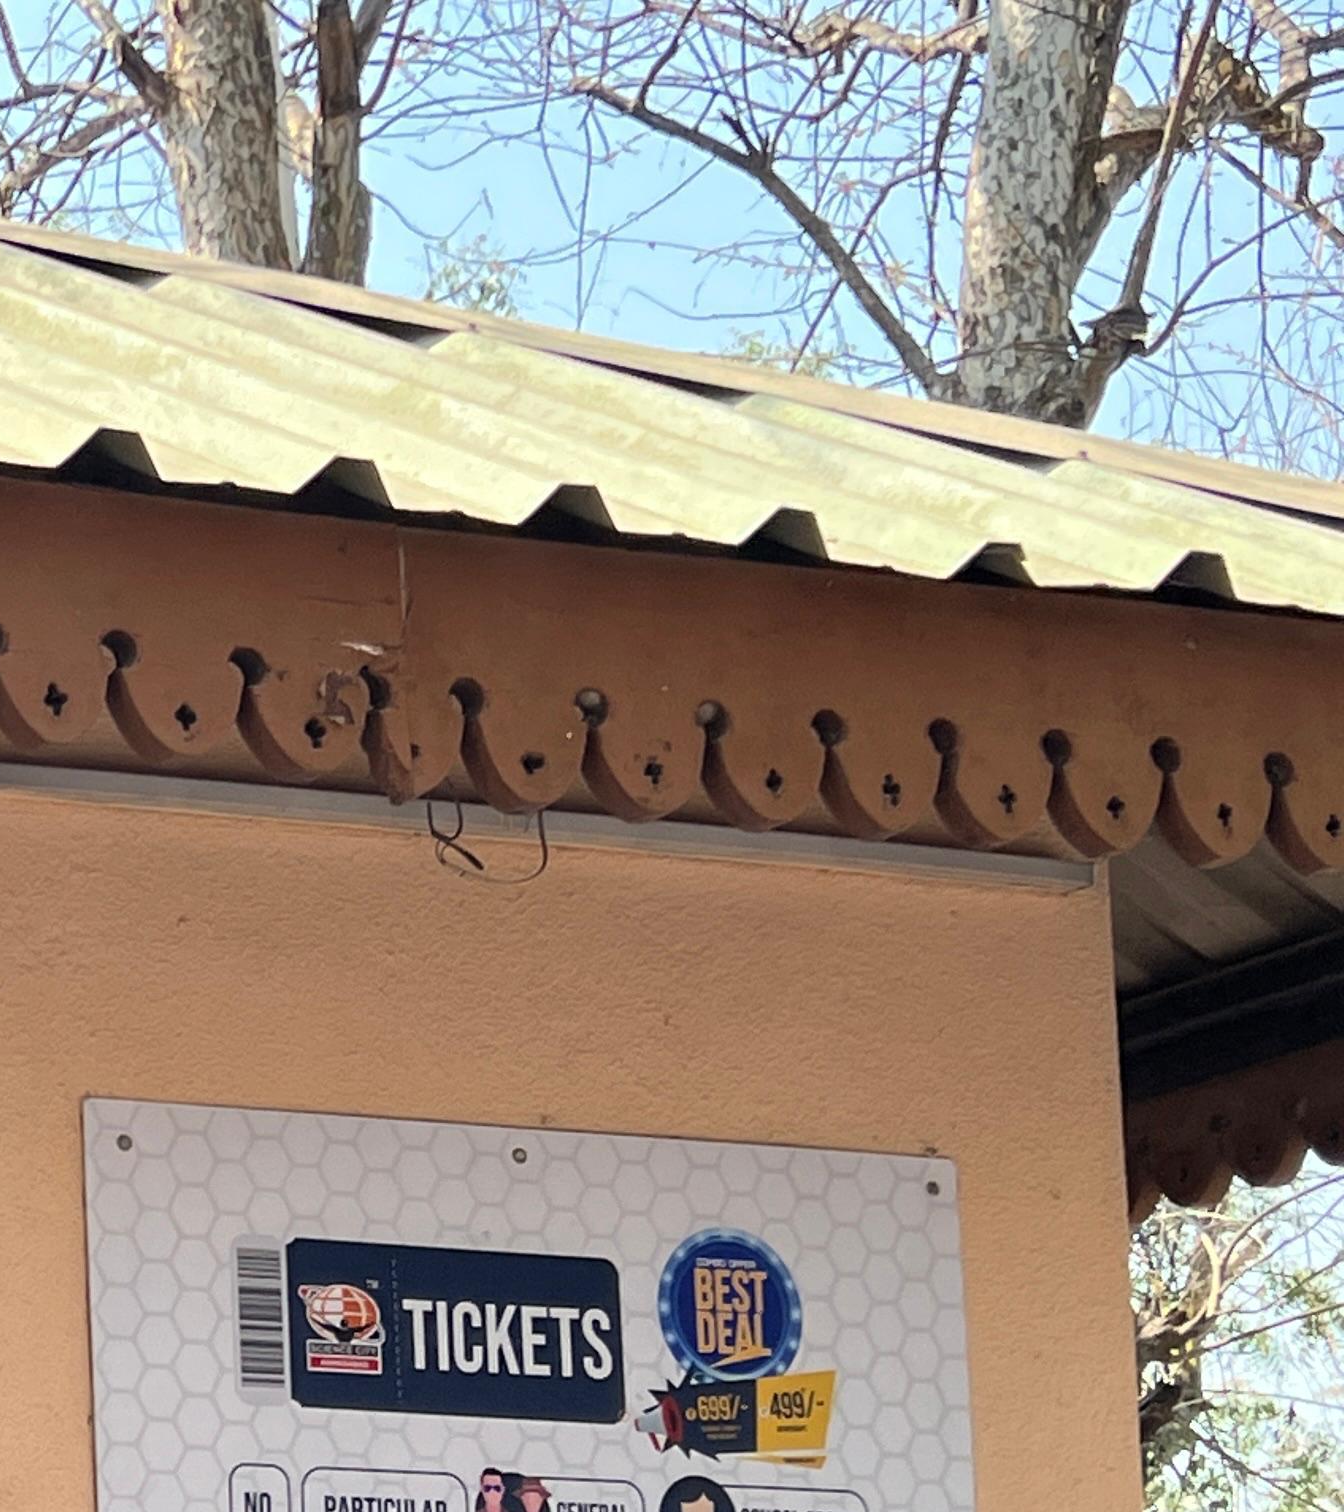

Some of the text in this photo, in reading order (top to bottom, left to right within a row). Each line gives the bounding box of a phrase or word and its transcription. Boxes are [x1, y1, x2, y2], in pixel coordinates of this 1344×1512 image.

[693, 1268, 767, 1313] BEST
[402, 1298, 613, 1380] TICKETS
[697, 1309, 772, 1357] DEAL
